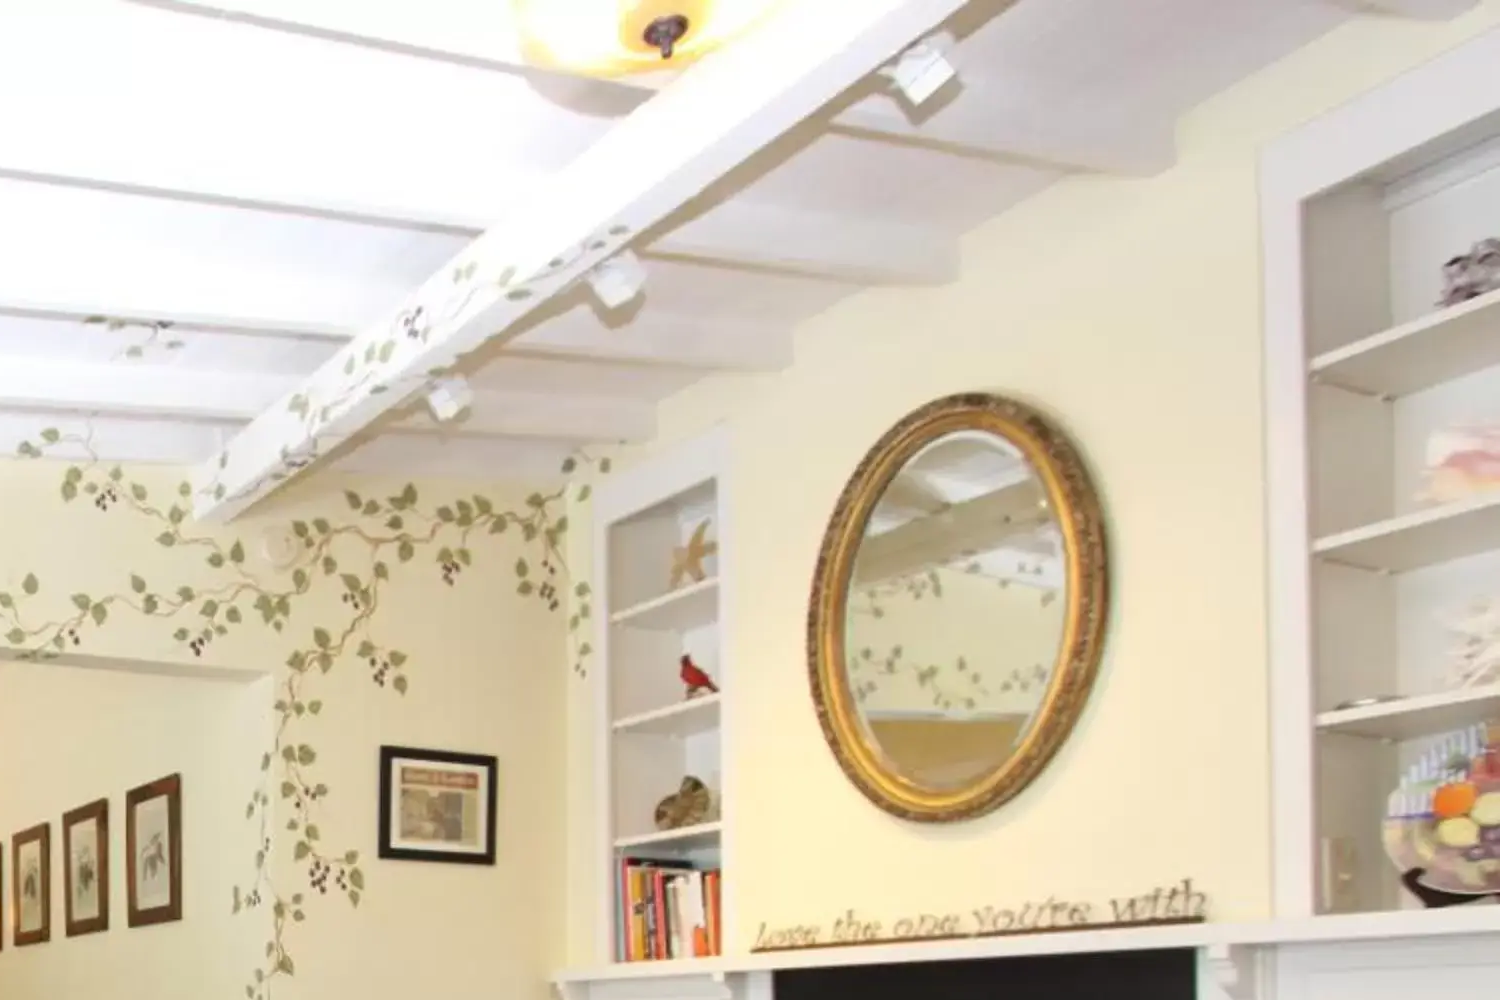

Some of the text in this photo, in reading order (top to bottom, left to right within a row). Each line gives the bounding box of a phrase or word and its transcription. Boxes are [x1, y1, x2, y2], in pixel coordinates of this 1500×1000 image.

[831, 909, 882, 943] the
[893, 914, 960, 938] one
[1108, 878, 1207, 921] with
